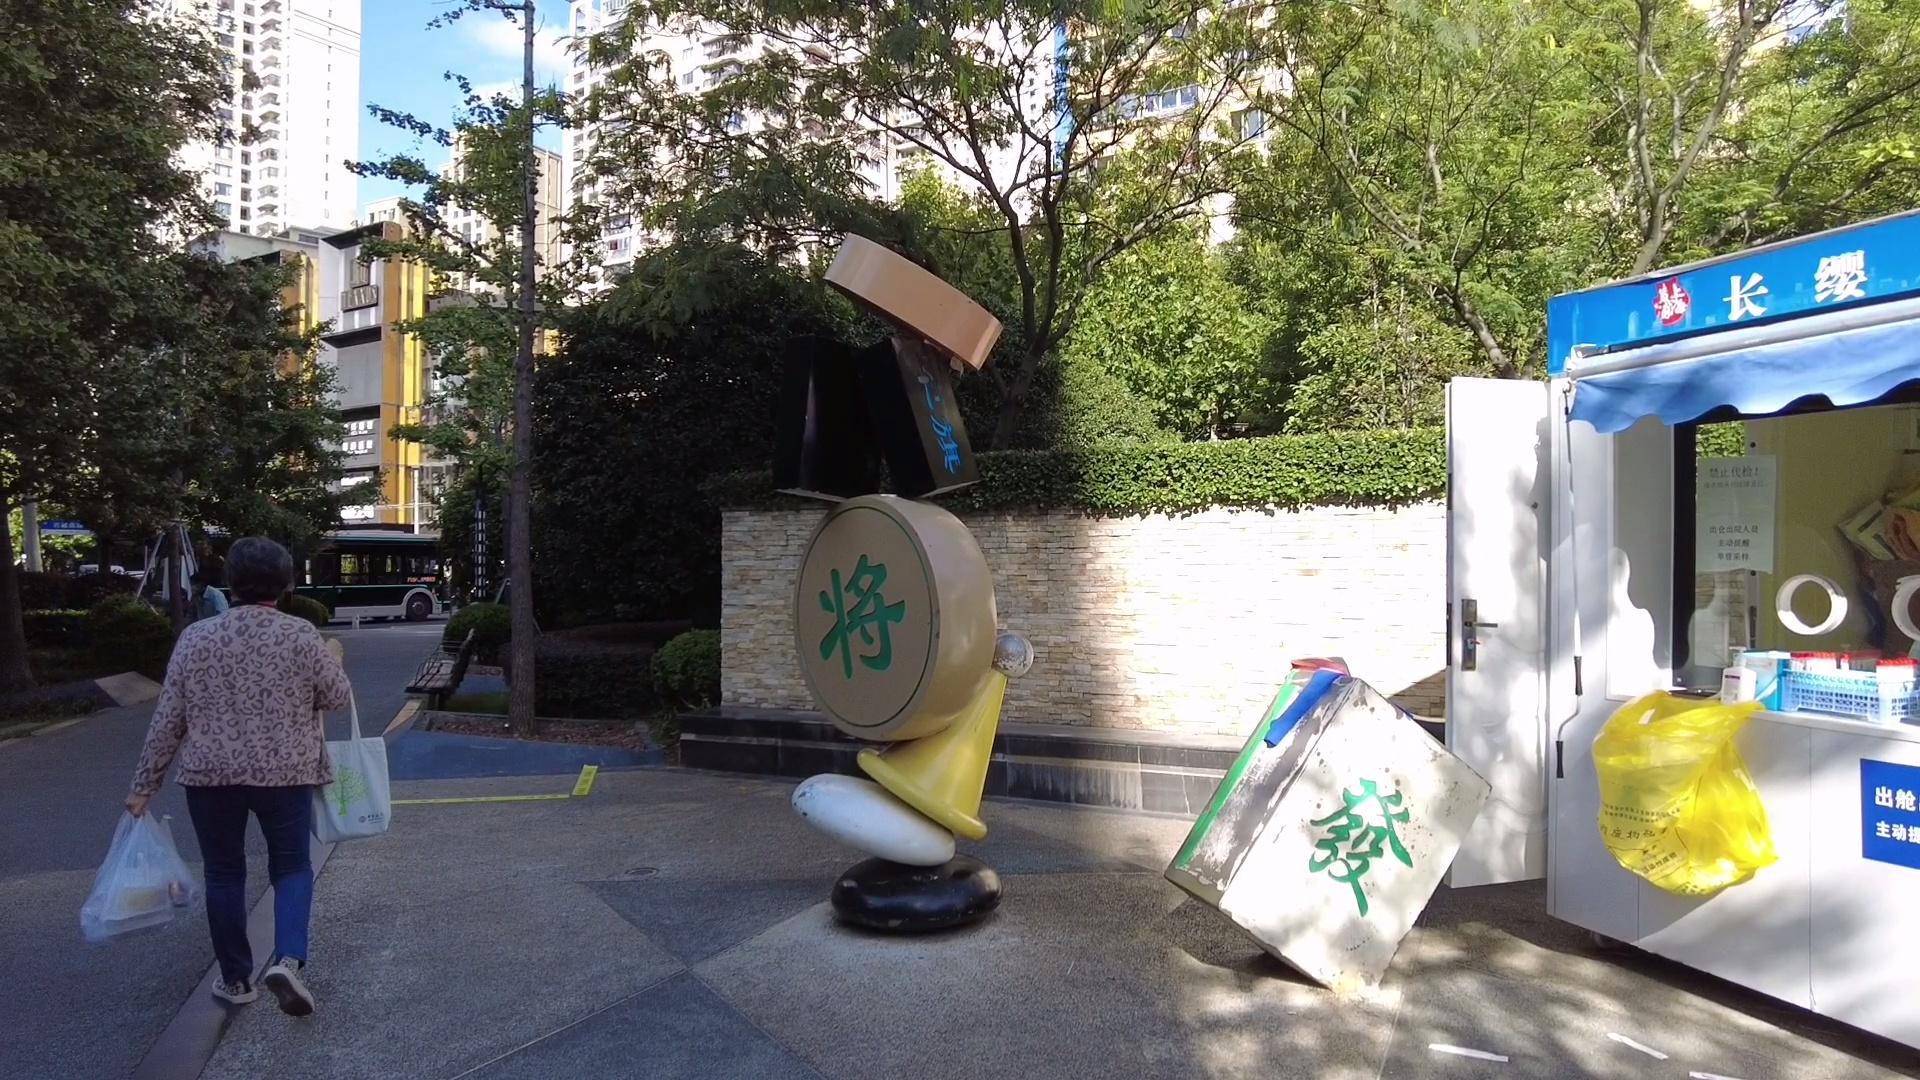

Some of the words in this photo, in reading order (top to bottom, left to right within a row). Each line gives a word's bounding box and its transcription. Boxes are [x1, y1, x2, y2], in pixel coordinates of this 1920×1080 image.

[1722, 250, 1868, 321] 长缨
[818, 553, 906, 680] 将
[1309, 776, 1414, 918] 發
[1875, 785, 1920, 812] 出舱
